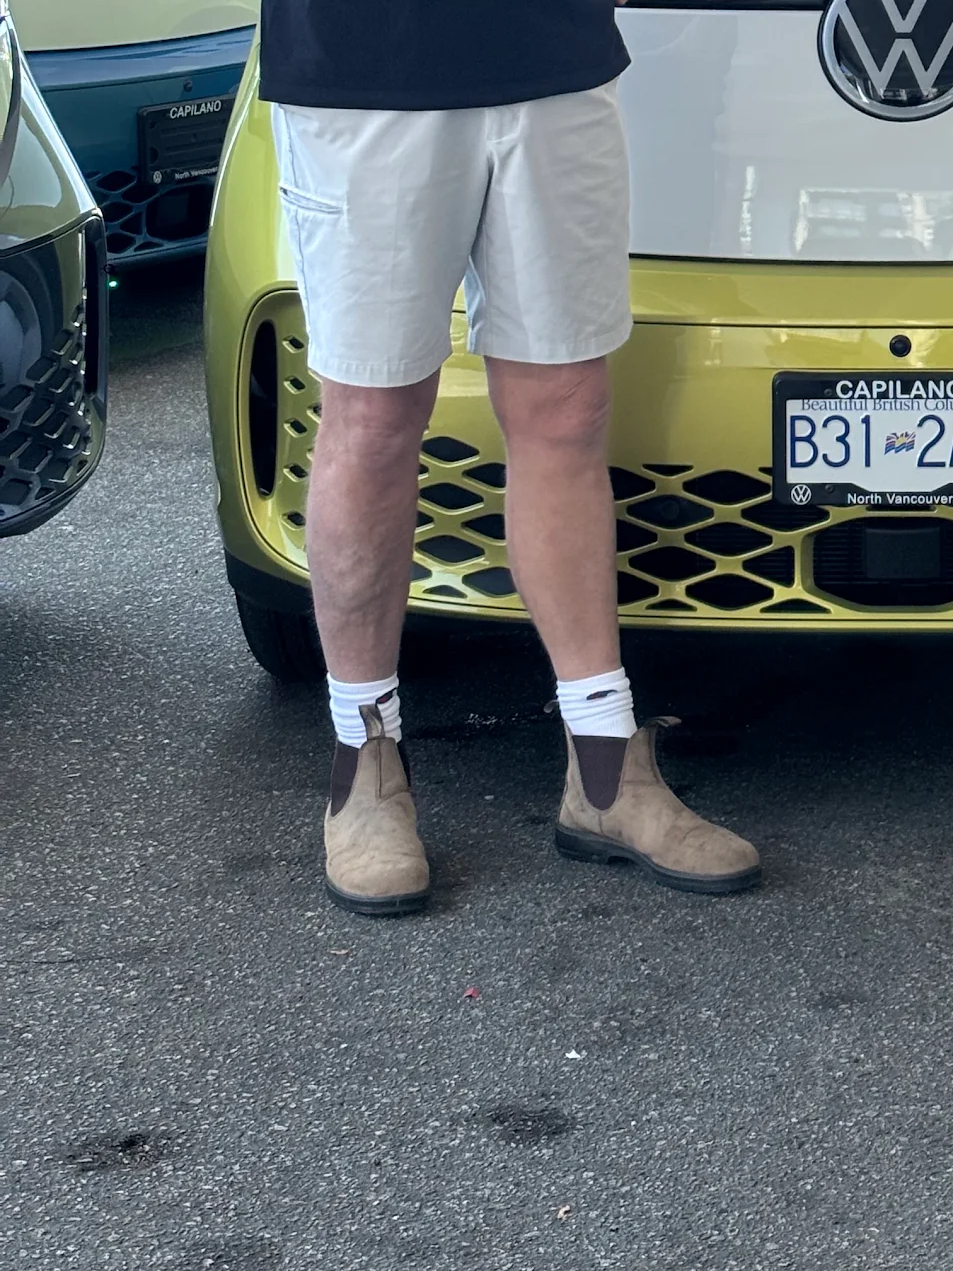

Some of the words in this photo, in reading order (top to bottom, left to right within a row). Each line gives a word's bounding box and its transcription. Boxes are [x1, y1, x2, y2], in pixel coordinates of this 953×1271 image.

[170, 100, 222, 119] CAPILANO
[801, 398, 868, 411] Beautiful
[872, 398, 920, 411] British
[789, 414, 871, 468] B31
[847, 492, 881, 504] North
[886, 492, 953, 505] Vancouver
